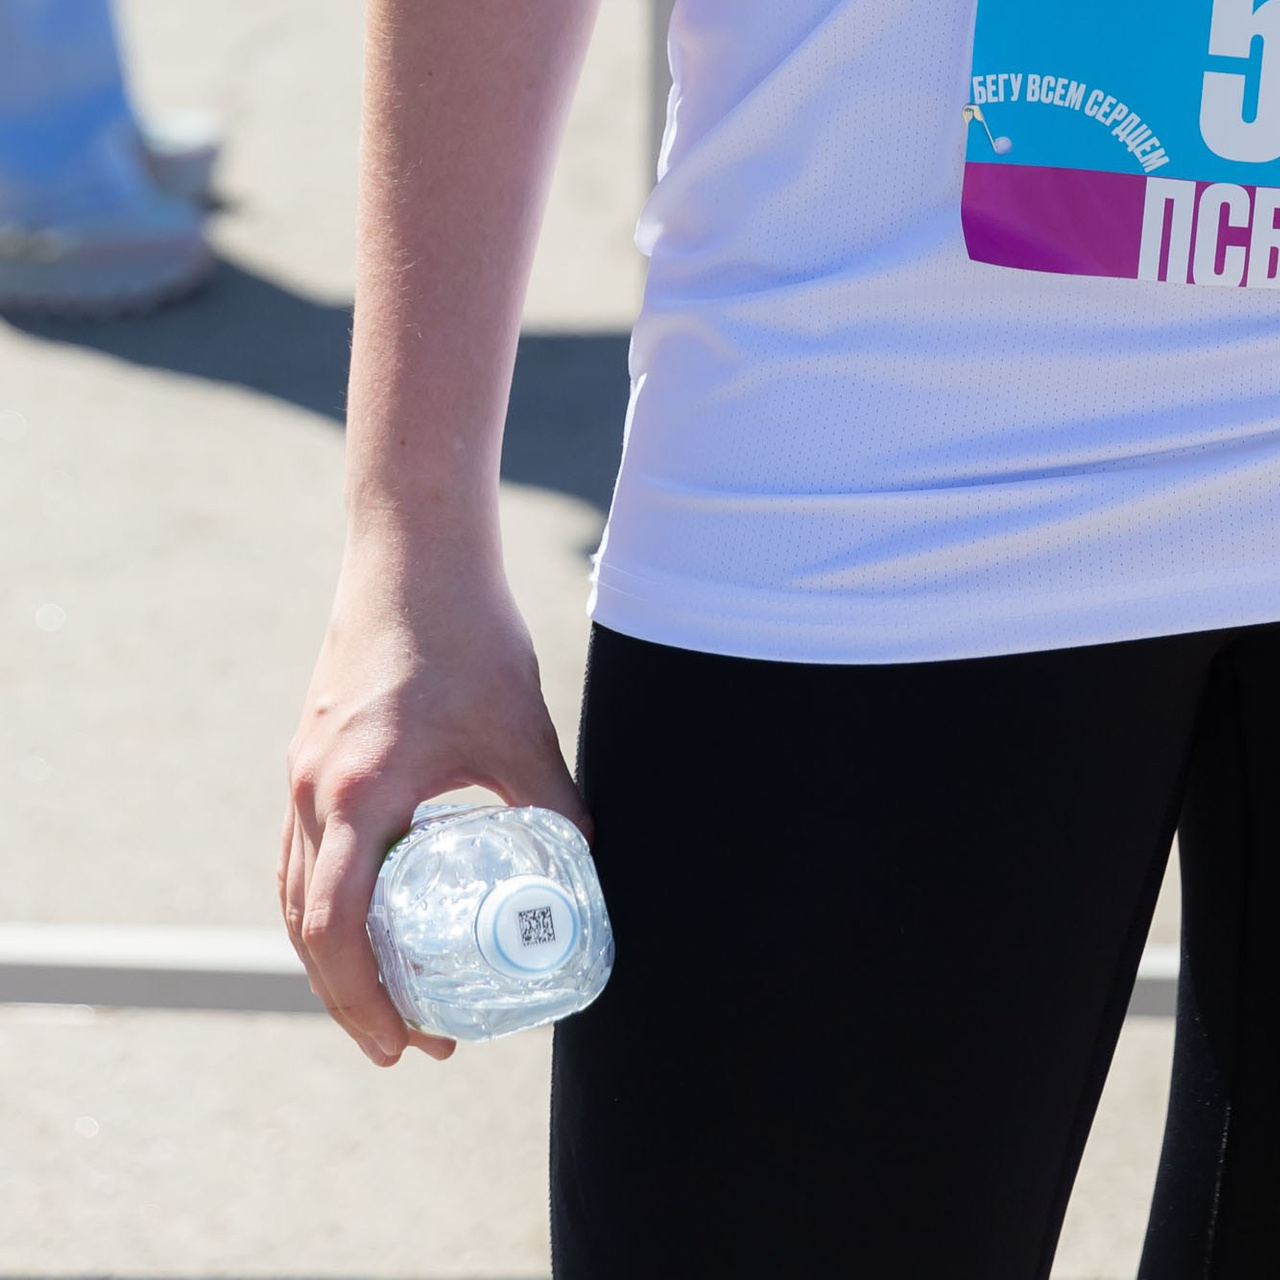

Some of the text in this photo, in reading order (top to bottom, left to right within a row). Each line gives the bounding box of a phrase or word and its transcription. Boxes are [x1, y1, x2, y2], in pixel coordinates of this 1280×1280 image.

[972, 73, 1171, 173] БЕГУ ВСЕМ СЕРДЦЕМ
